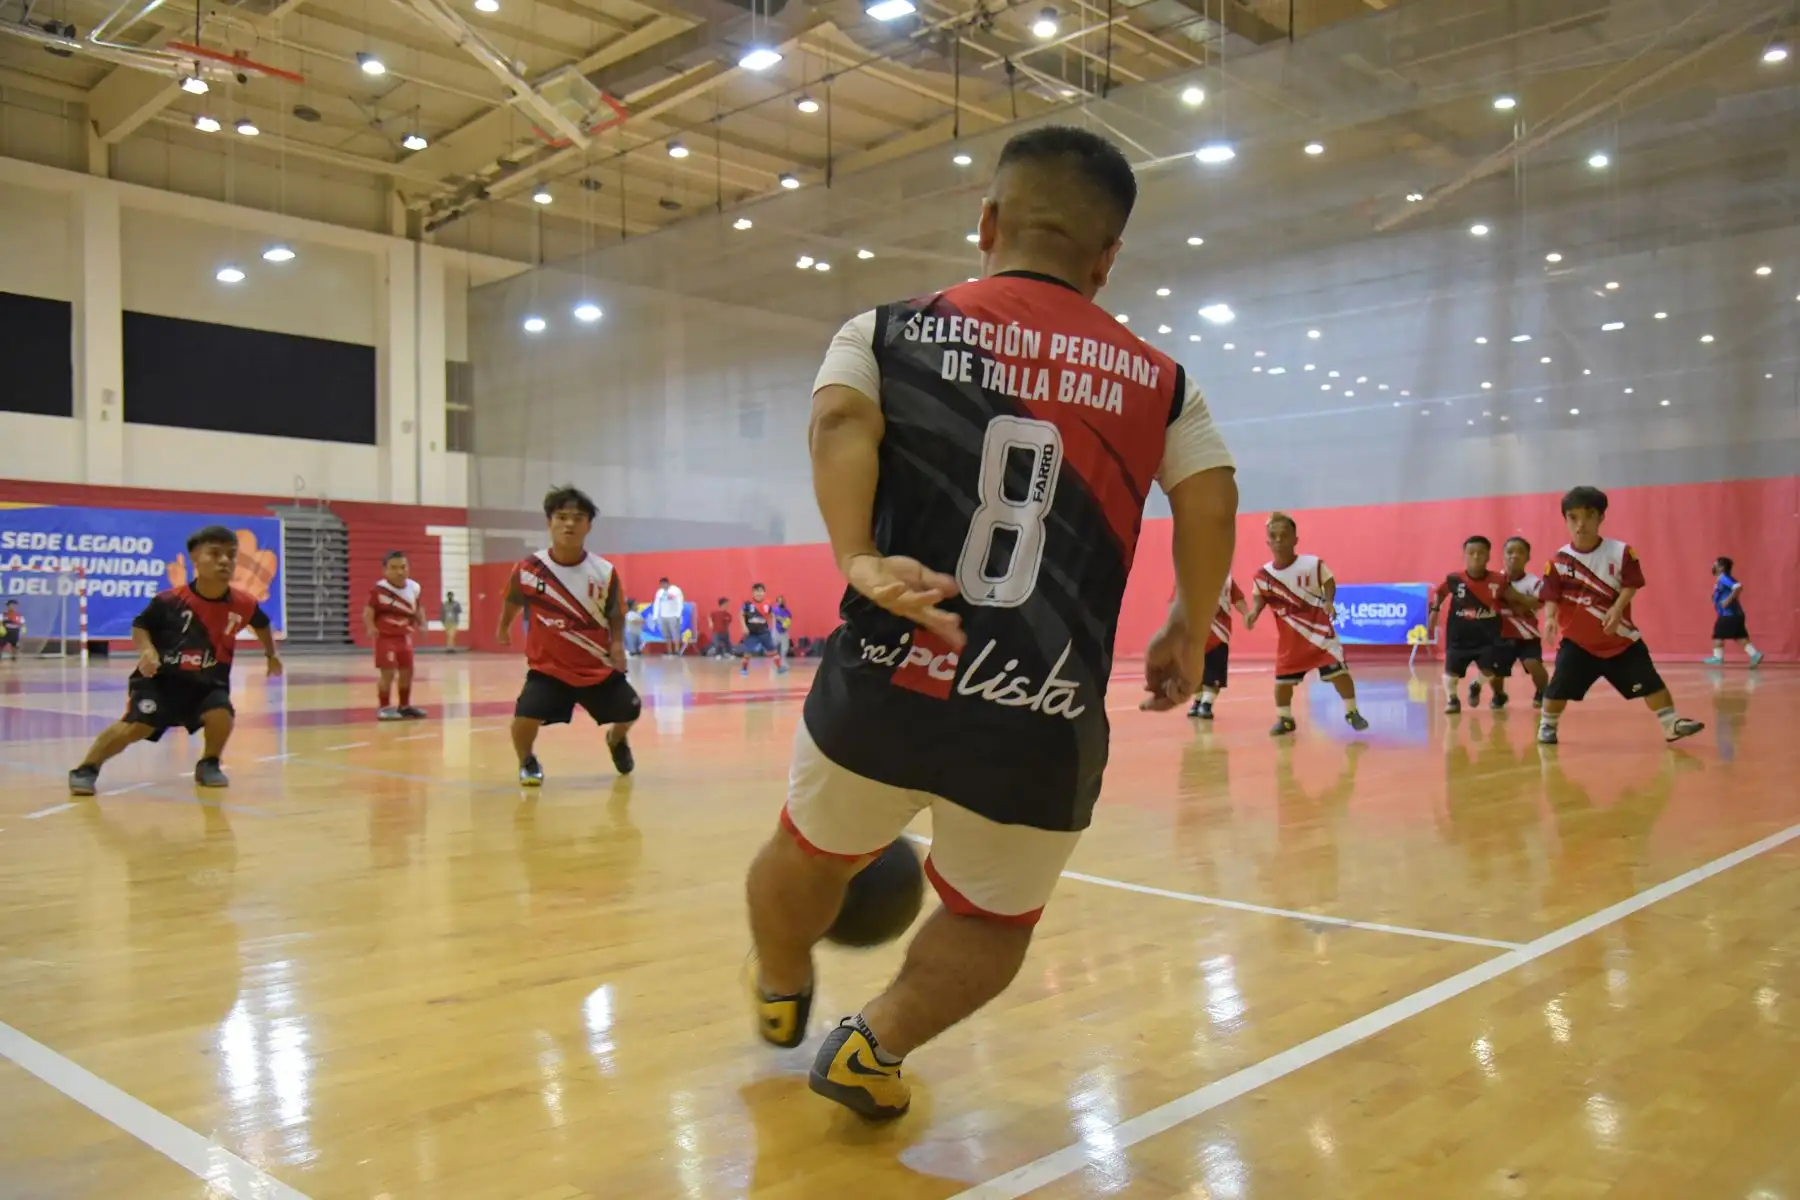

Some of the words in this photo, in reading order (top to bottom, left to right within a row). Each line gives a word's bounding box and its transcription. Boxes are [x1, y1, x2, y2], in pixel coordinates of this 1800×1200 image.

[904, 312, 1041, 360] SELECCIÓN
[941, 350, 973, 383] DE
[981, 359, 1050, 402] TALLA
[1057, 370, 1123, 415] BAJA
[1033, 444, 1054, 503] FARRO
[955, 415, 1063, 607] 8
[1, 531, 63, 551] SEDE
[65, 533, 154, 555] LEGADO
[28, 554, 165, 577] COMUNIDAD
[8, 577, 53, 596] DEL
[57, 577, 159, 598] DEPORTE
[181, 610, 193, 634] 7
